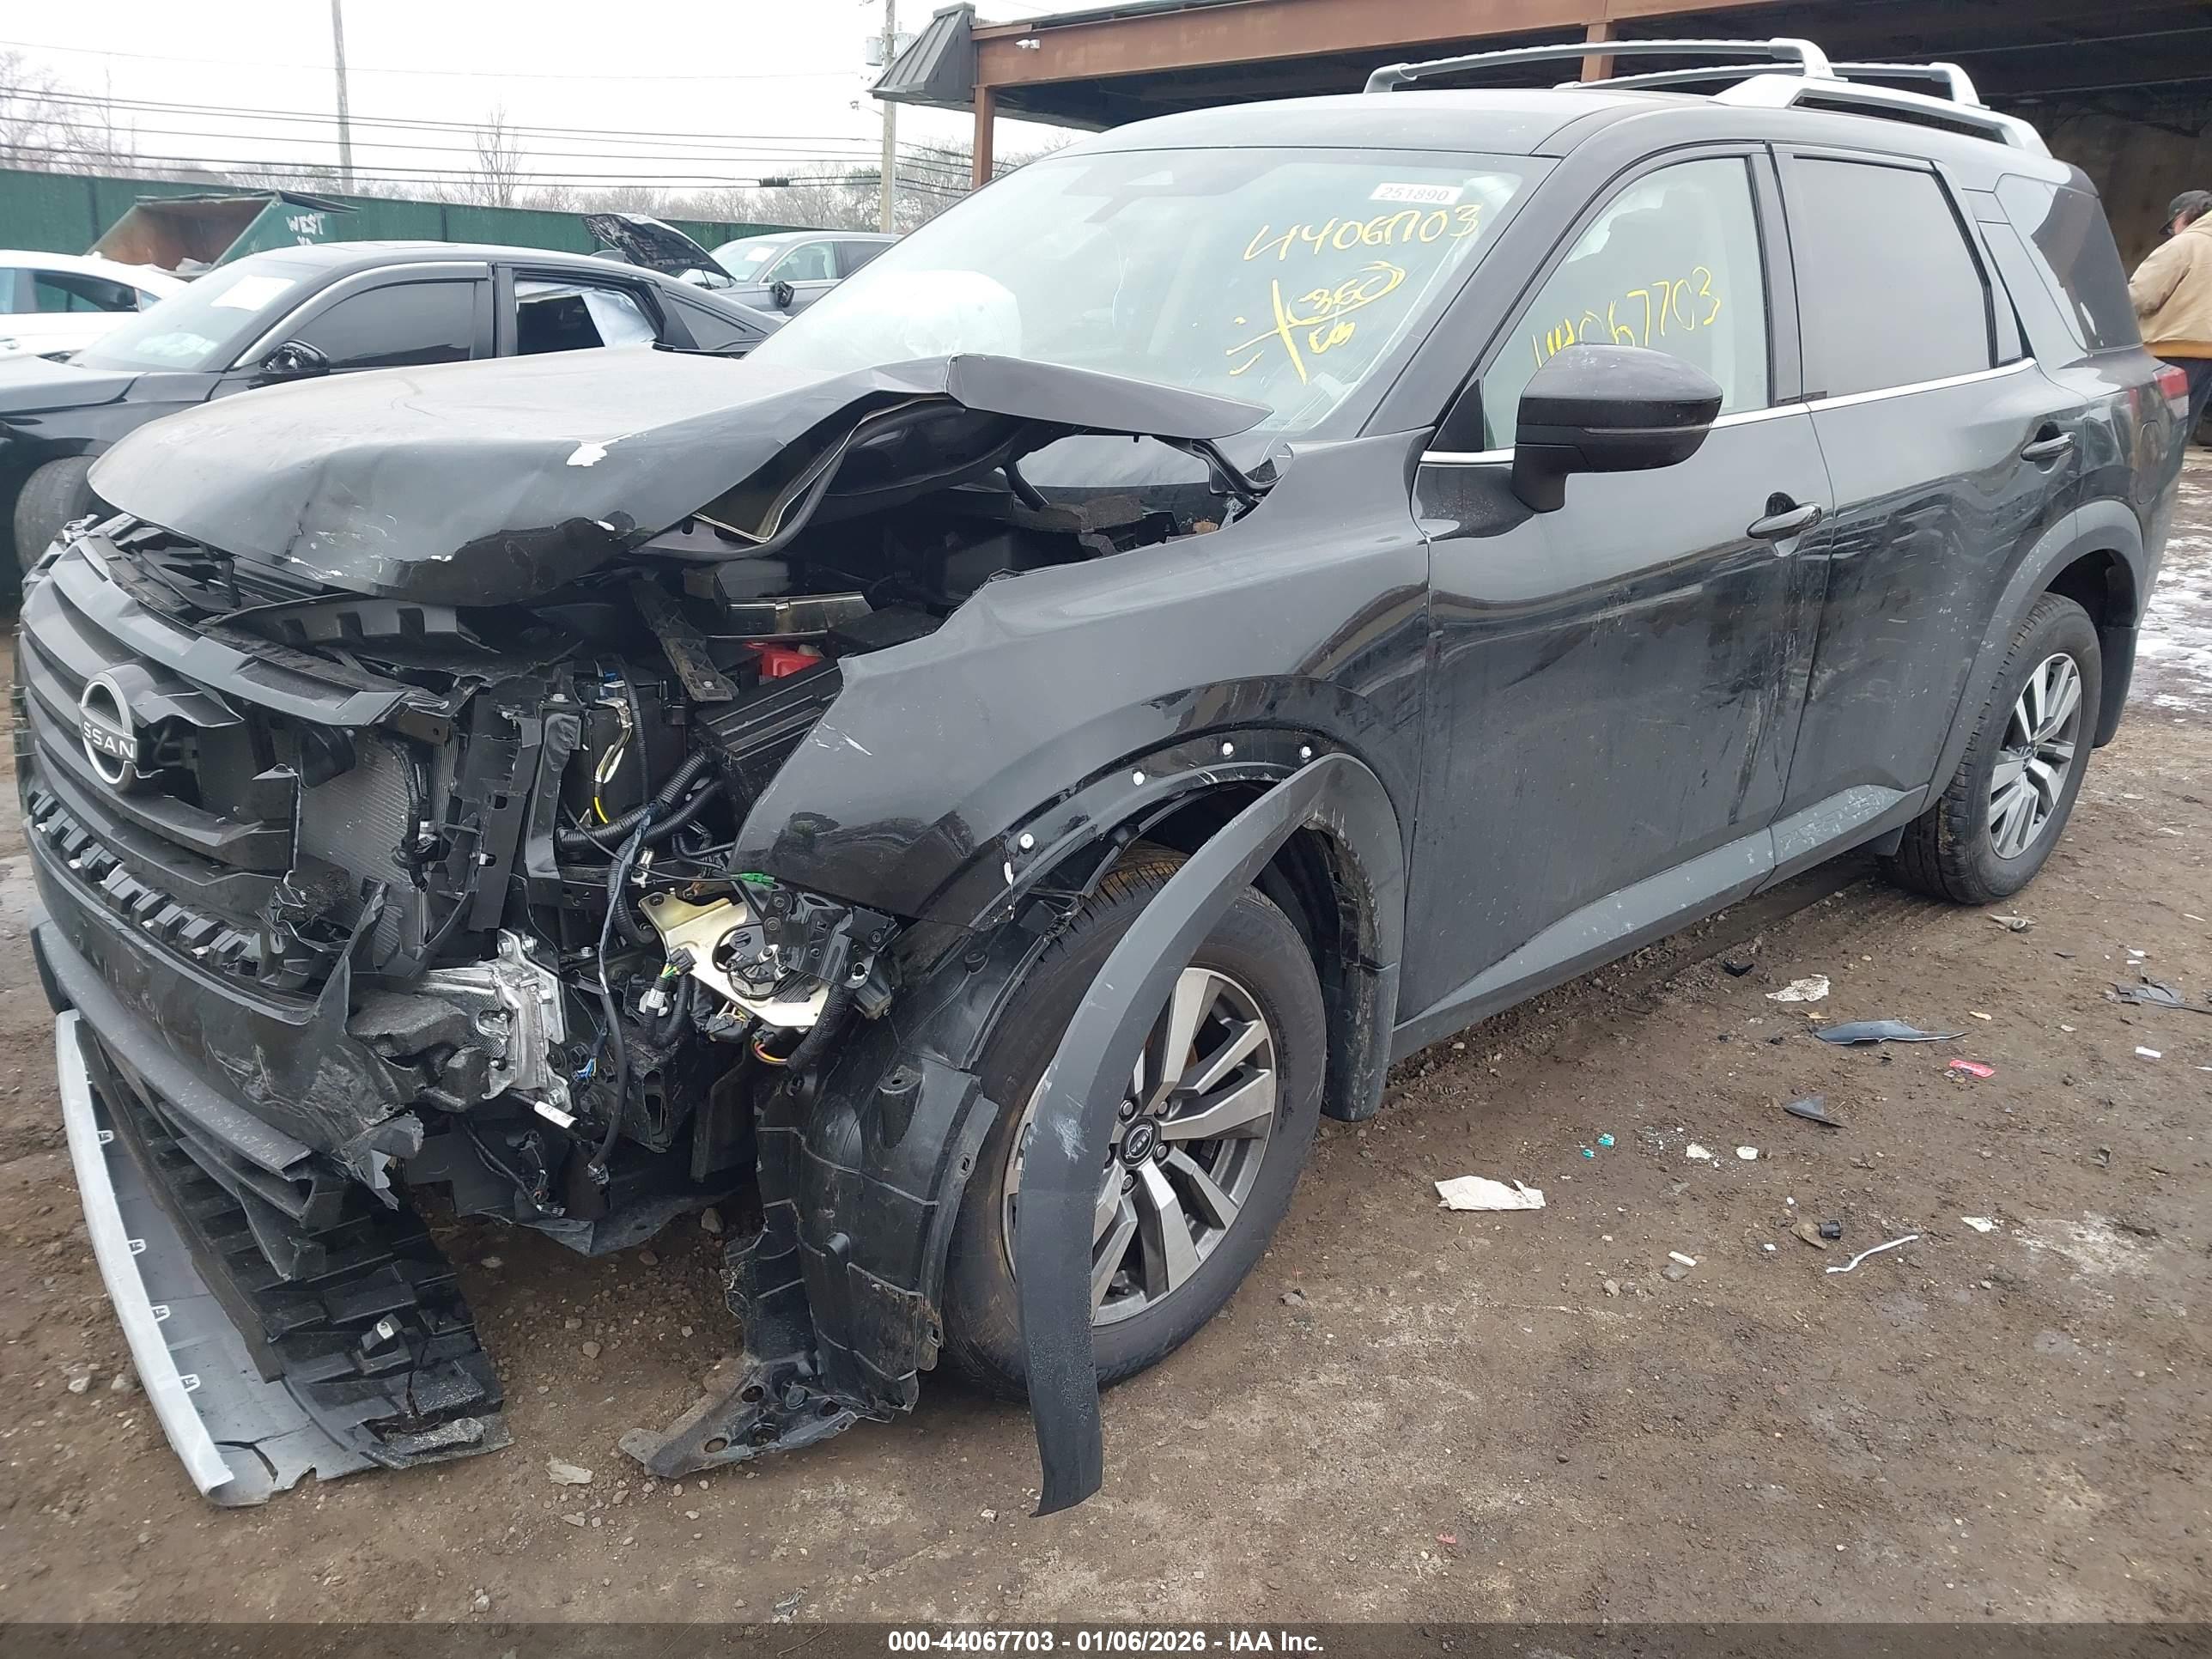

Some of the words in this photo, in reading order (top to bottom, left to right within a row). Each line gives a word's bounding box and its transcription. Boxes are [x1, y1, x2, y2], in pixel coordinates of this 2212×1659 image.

[1379, 186, 1449, 202] 251890
[285, 213, 325, 235] WEST
[82, 720, 134, 759] SSAN
